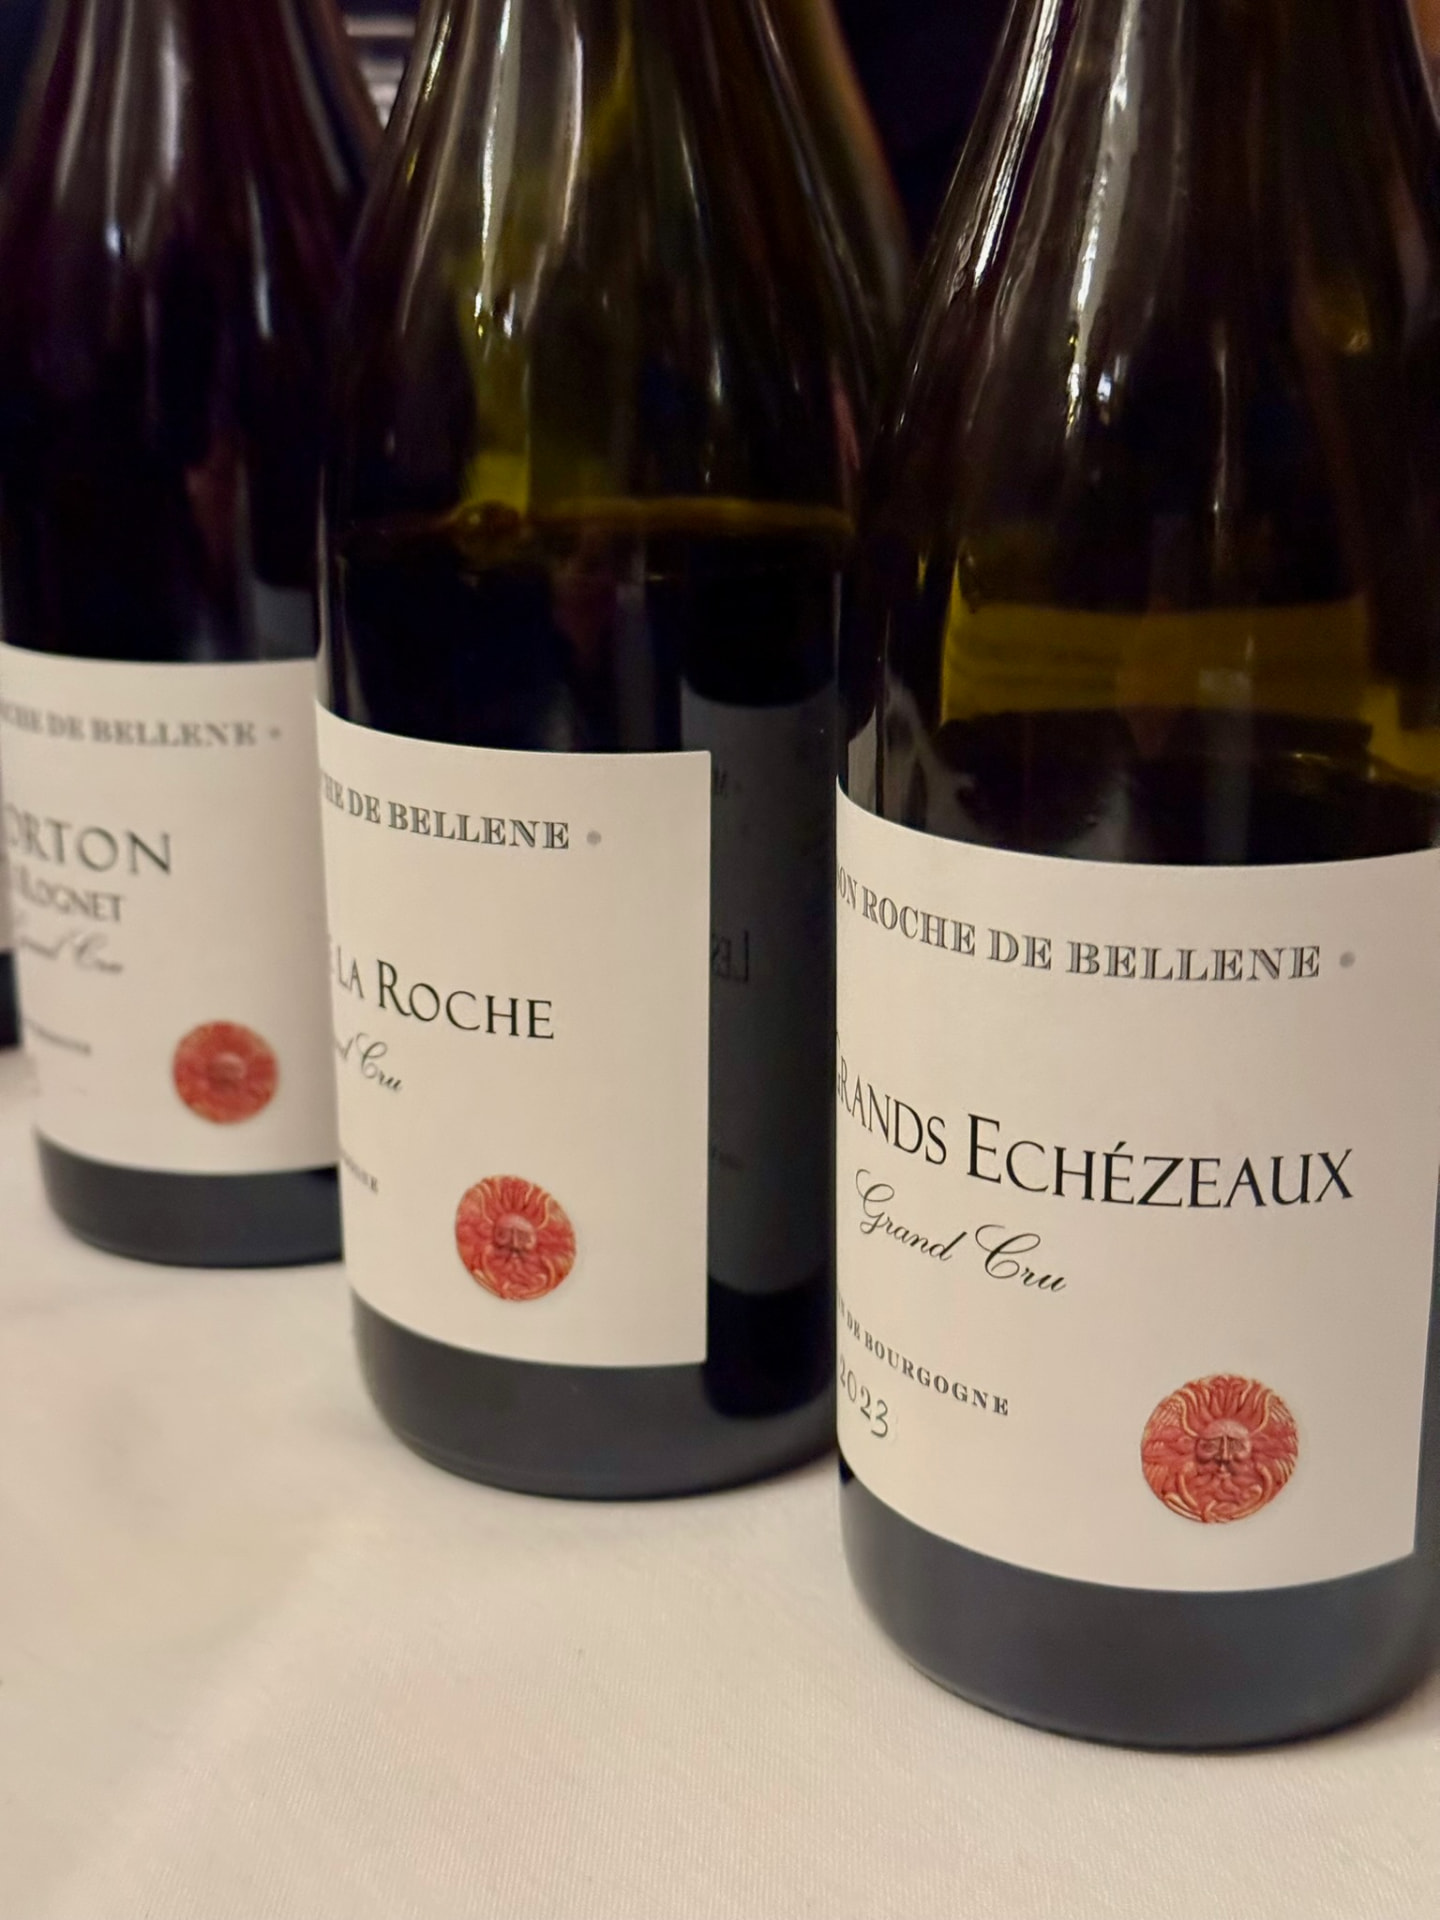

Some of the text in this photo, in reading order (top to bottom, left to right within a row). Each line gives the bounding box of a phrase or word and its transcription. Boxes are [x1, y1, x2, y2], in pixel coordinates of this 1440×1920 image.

[46, 710, 85, 741] DE
[90, 715, 257, 748] BELLENE
[2, 801, 171, 876] ORTON
[347, 786, 381, 825] DE
[387, 799, 570, 850] BELLENE
[861, 885, 976, 957] ROCHE
[987, 927, 1052, 971] DE
[1066, 940, 1321, 982] BELLENE
[336, 944, 555, 1040] LA ROCHE
[355, 1032, 402, 1092] Cru
[966, 1112, 1354, 1209] ECHÉZEAUX
[855, 1168, 1067, 1293] Grand Cru
[839, 1353, 890, 1439] 2023
[847, 1309, 1009, 1416] DE BOURGOGNE
